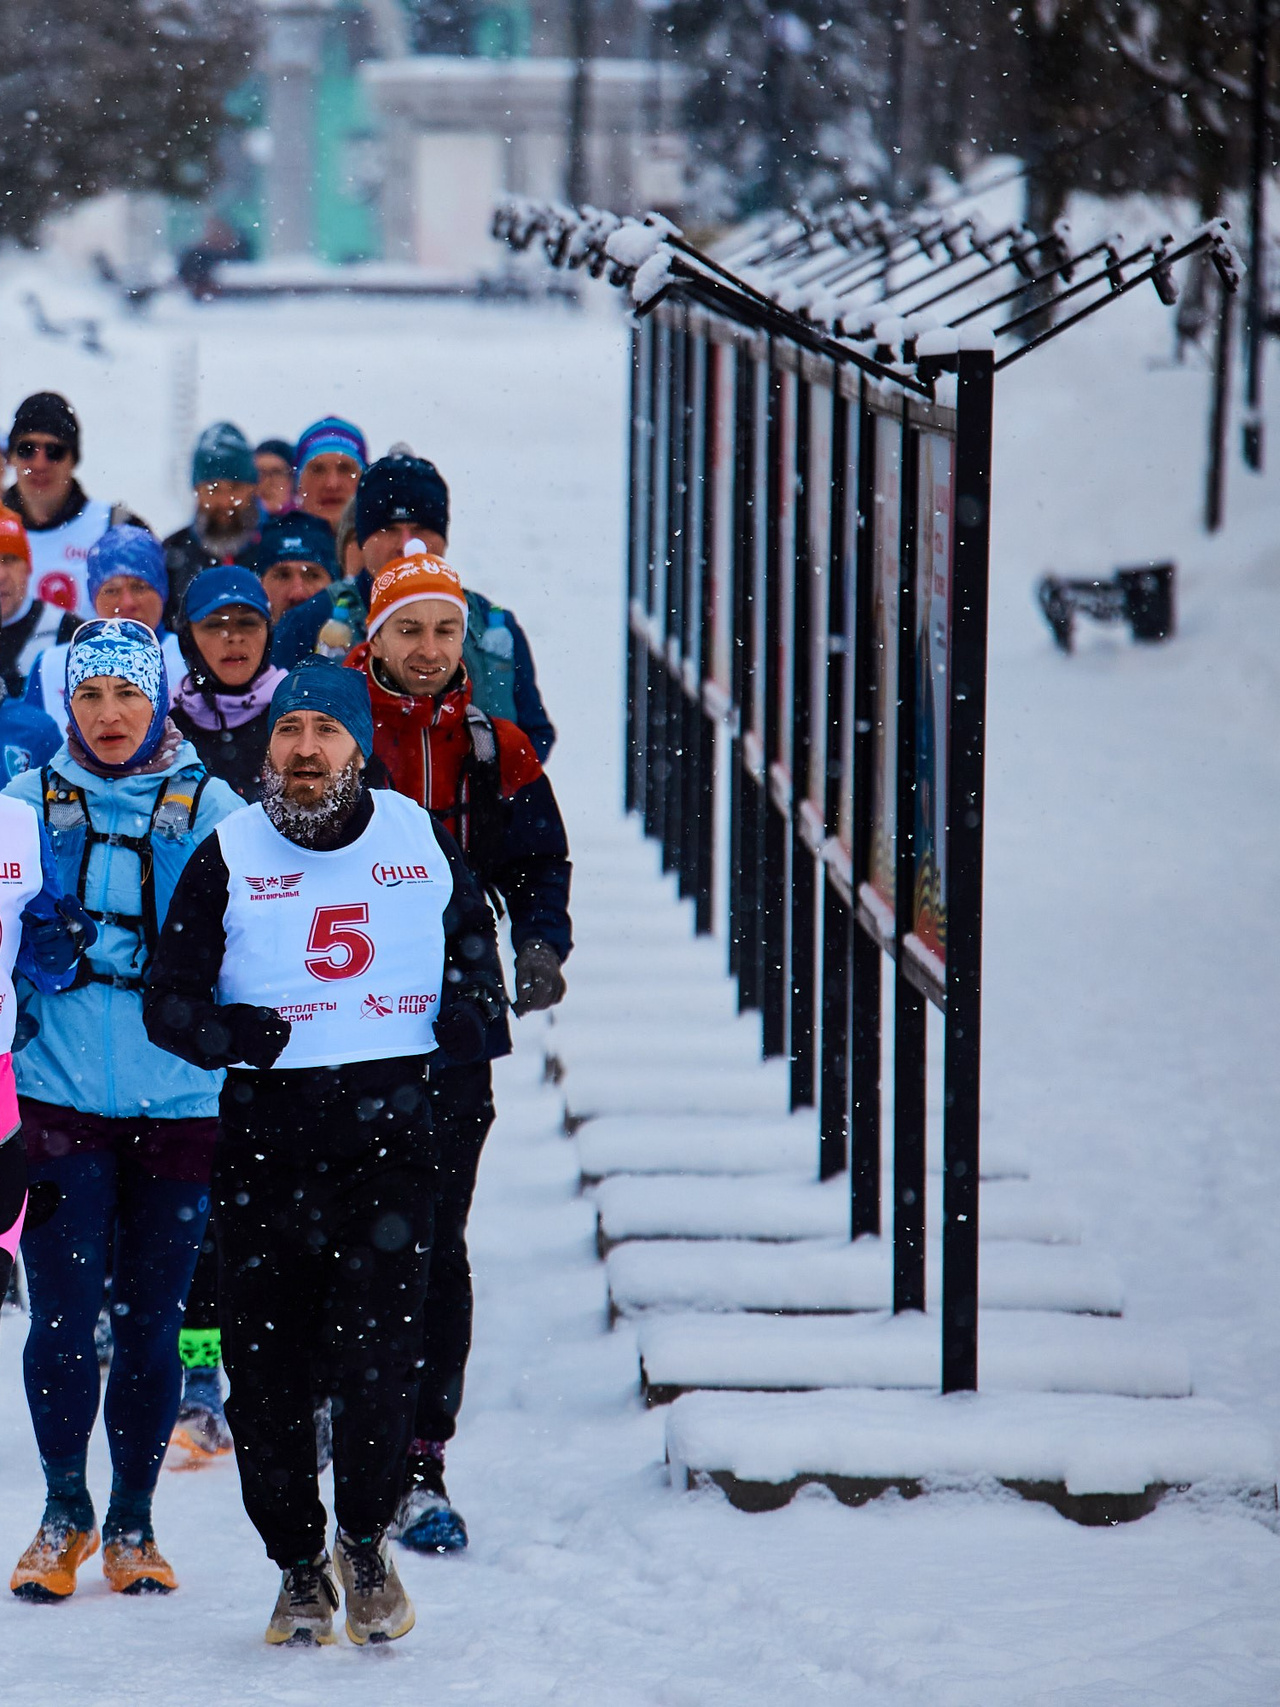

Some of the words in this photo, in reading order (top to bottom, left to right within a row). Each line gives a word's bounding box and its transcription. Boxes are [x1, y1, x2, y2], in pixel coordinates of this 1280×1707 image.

[380, 865, 429, 881] НЦВ
[250, 890, 300, 901] ВИНТОКРЫЛЫЕ
[305, 902, 376, 983] 5
[398, 993, 437, 1004] ППОО
[398, 1004, 427, 1015] НЦВ
